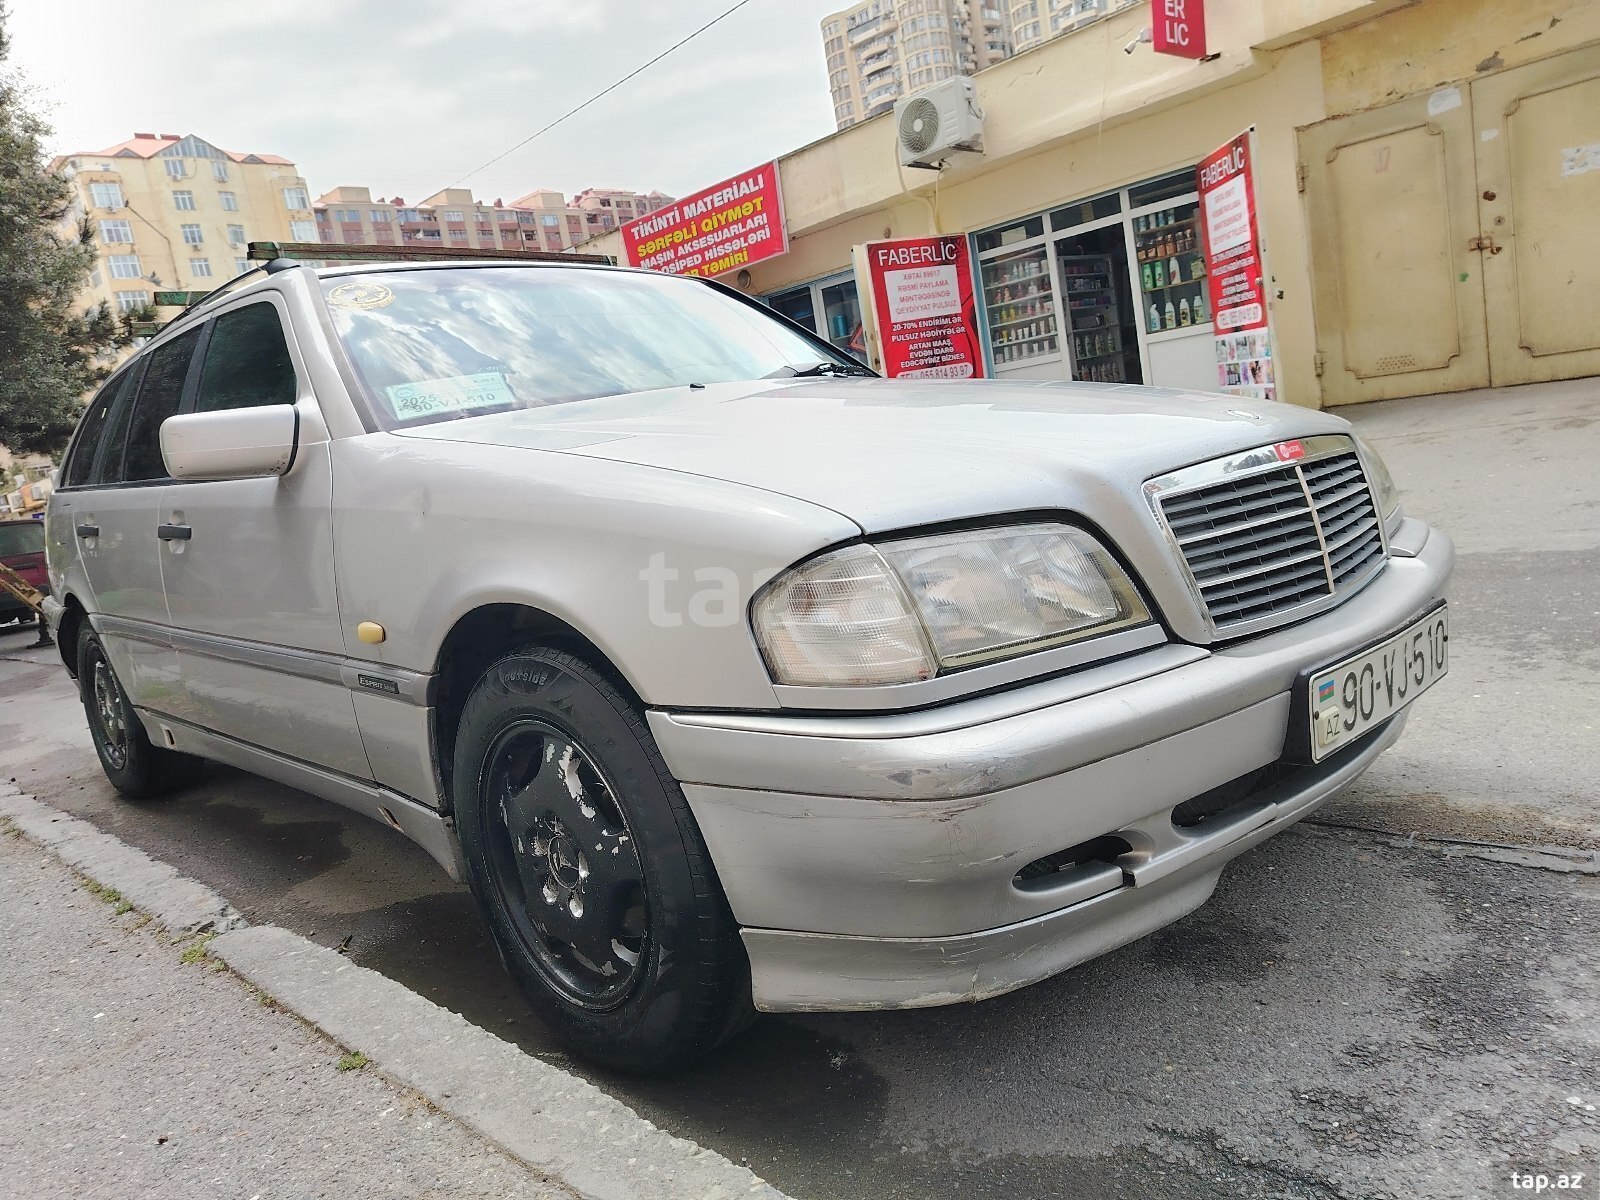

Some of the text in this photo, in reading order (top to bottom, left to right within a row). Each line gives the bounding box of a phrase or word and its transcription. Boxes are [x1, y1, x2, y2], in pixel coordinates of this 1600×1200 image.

[1166, 20, 1189, 46] LIC
[1200, 146, 1245, 190] FABERLİC
[631, 173, 765, 241] TİKİNTİ MATERİALI
[637, 196, 764, 258] SƏRFƏLİ QİYMƏT
[640, 212, 768, 270] MAŞIN AKSESUARLARI
[657, 224, 771, 274] OSİPED HİSSƏLƏRİ
[878, 241, 957, 267] FABERLİC
[702, 247, 749, 276] TƏMİRİ
[920, 280, 949, 289] PAYLAMA
[932, 300, 957, 309] PULSUZ
[891, 332, 919, 342] PULSUZ
[892, 321, 917, 332] 20-70%
[909, 341, 932, 351] ARTAN
[909, 349, 933, 359] EVDƏN
[400, 393, 437, 406] 2025
[414, 393, 496, 413] 90-VJ-510
[1343, 619, 1445, 732] 90-VJ-510
[1325, 714, 1341, 741] AZ
